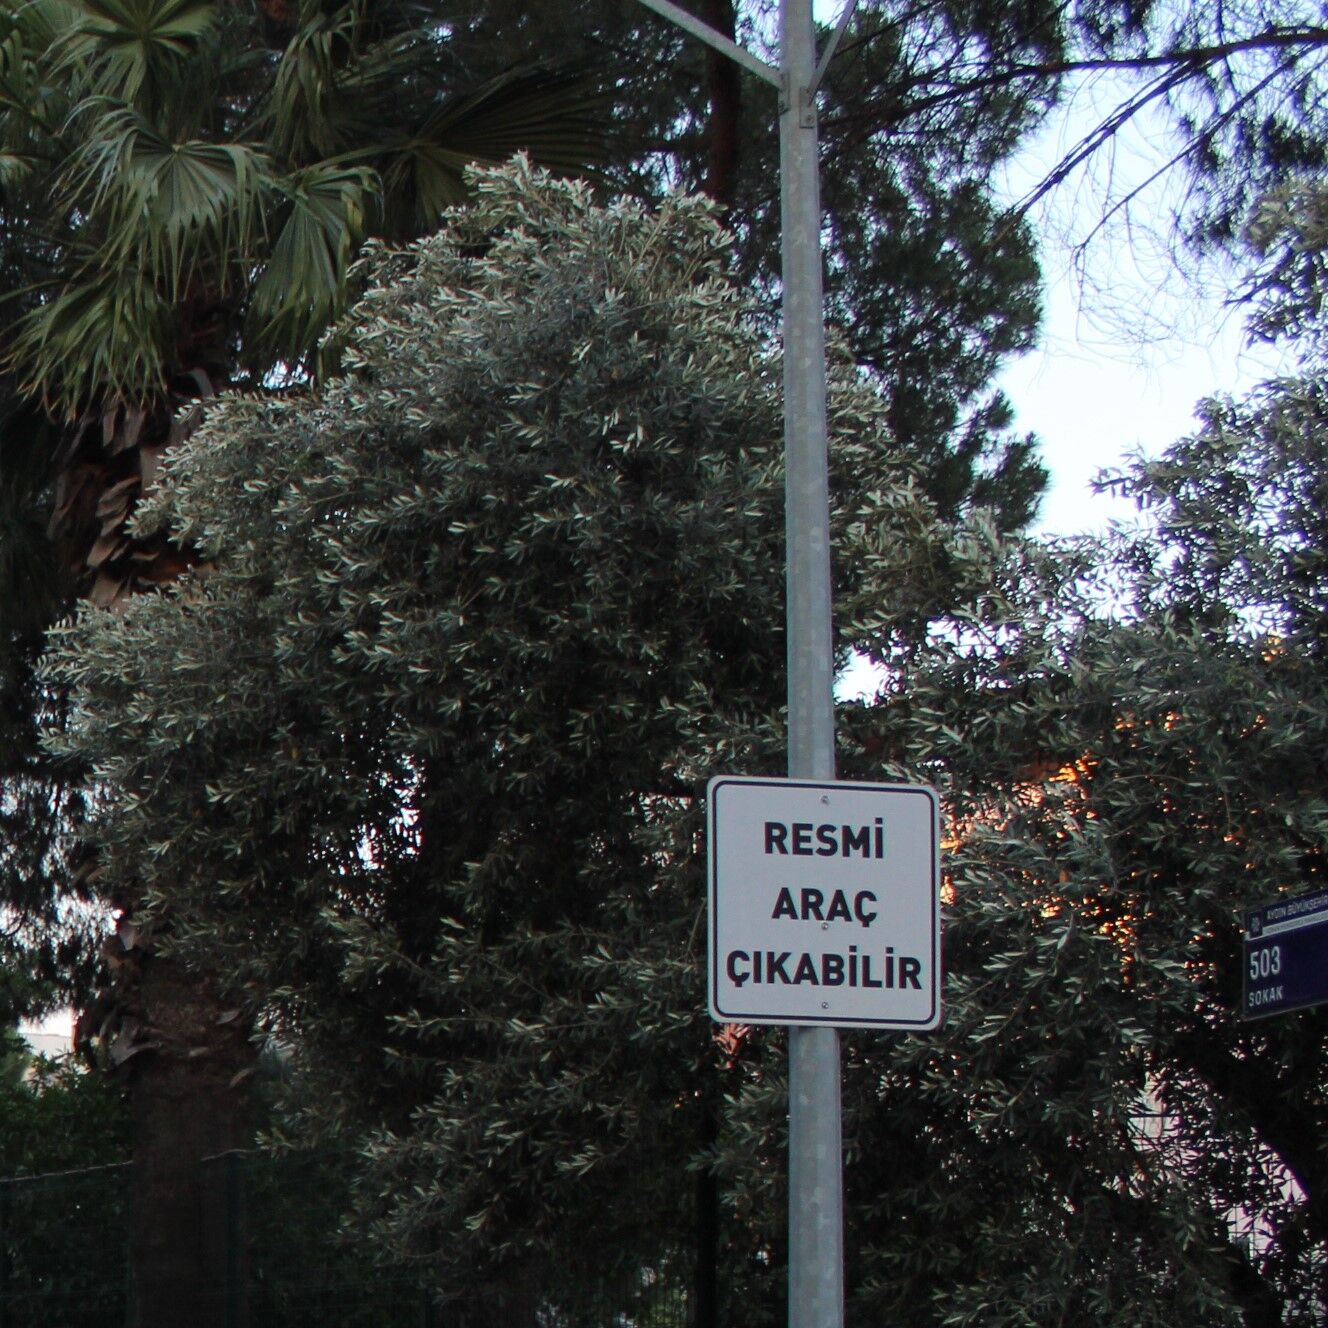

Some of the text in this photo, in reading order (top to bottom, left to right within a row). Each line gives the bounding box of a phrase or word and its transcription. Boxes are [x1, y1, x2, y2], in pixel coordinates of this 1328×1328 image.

[764, 817, 883, 859] RESMİ
[771, 887, 877, 927] ARAÇ
[726, 945, 922, 990] ÇIKABİLİR
[1250, 945, 1280, 980] 503
[1248, 985, 1283, 1007] SOKAK
